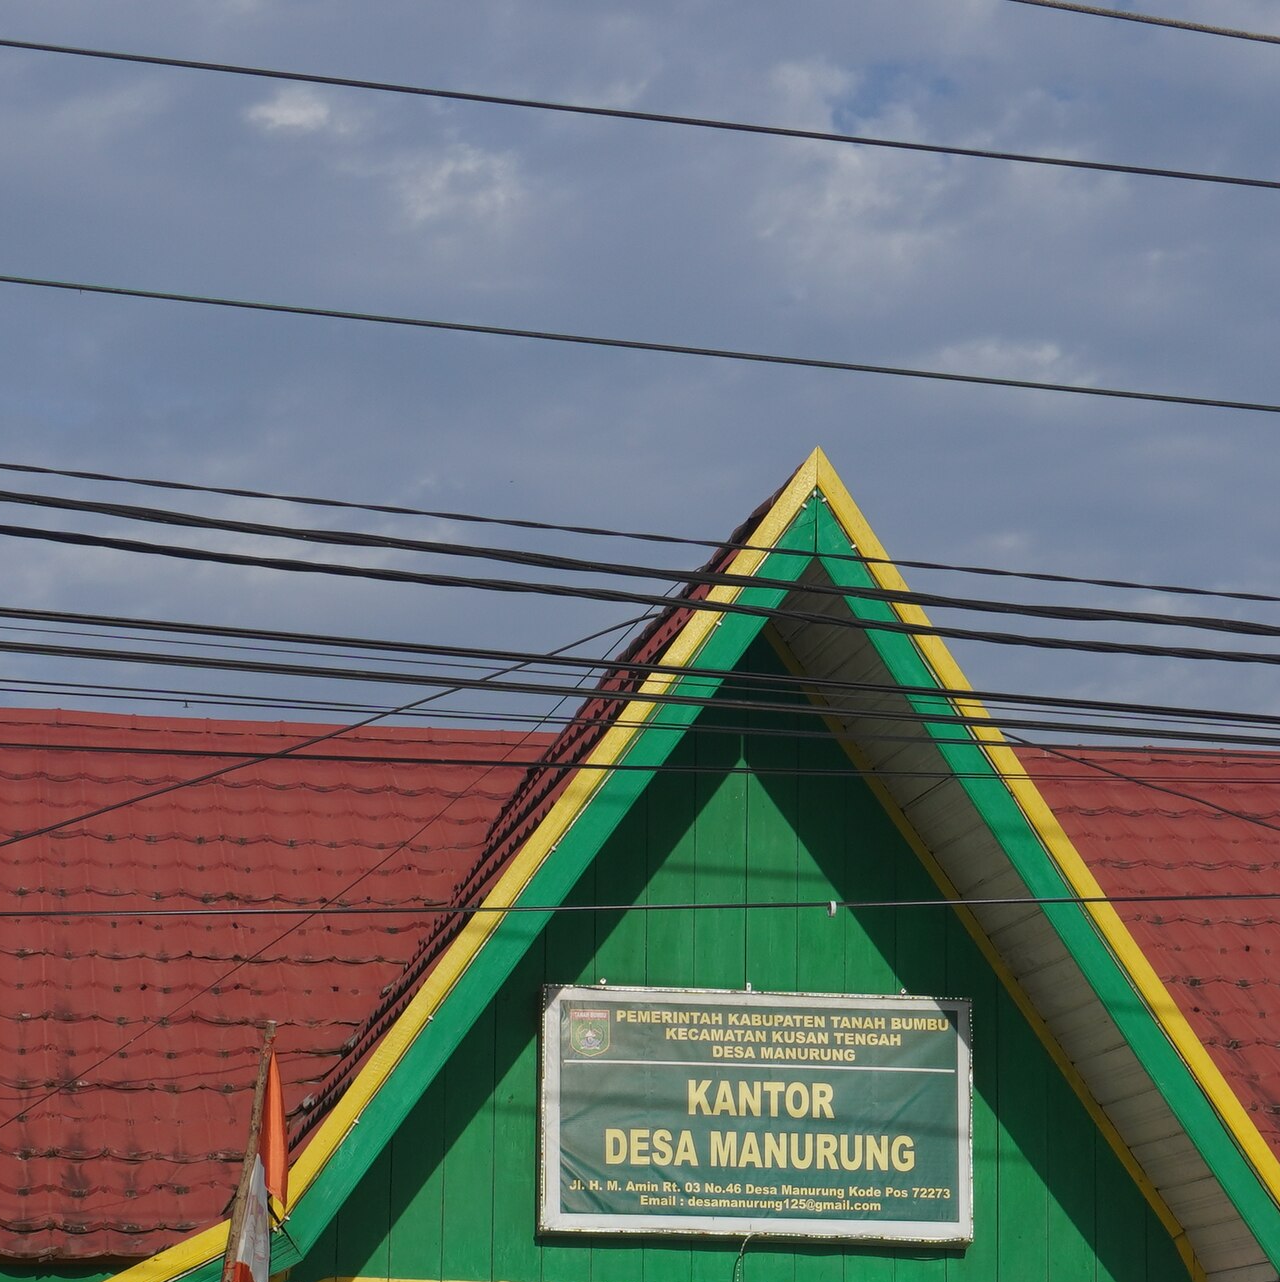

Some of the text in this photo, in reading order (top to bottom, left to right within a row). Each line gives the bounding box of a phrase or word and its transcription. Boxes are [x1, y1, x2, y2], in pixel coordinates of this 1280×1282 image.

[616, 1010, 949, 1032] PEMERINTAH KABUPATEN TANAH BUMBU
[665, 1027, 901, 1047] KECAMATAN KUSAN TENGAH
[712, 1045, 856, 1062] DESA MANURUNG
[687, 1079, 835, 1119] KANTOR
[604, 1128, 916, 1172] DESA MANURUNG
[569, 1180, 951, 1199] Jl. H. M. Amin Rt. 03 No.46 Desa Manurung Kode Pos 72273
[640, 1195, 881, 1212] Email desamanurung125@gmail.com
